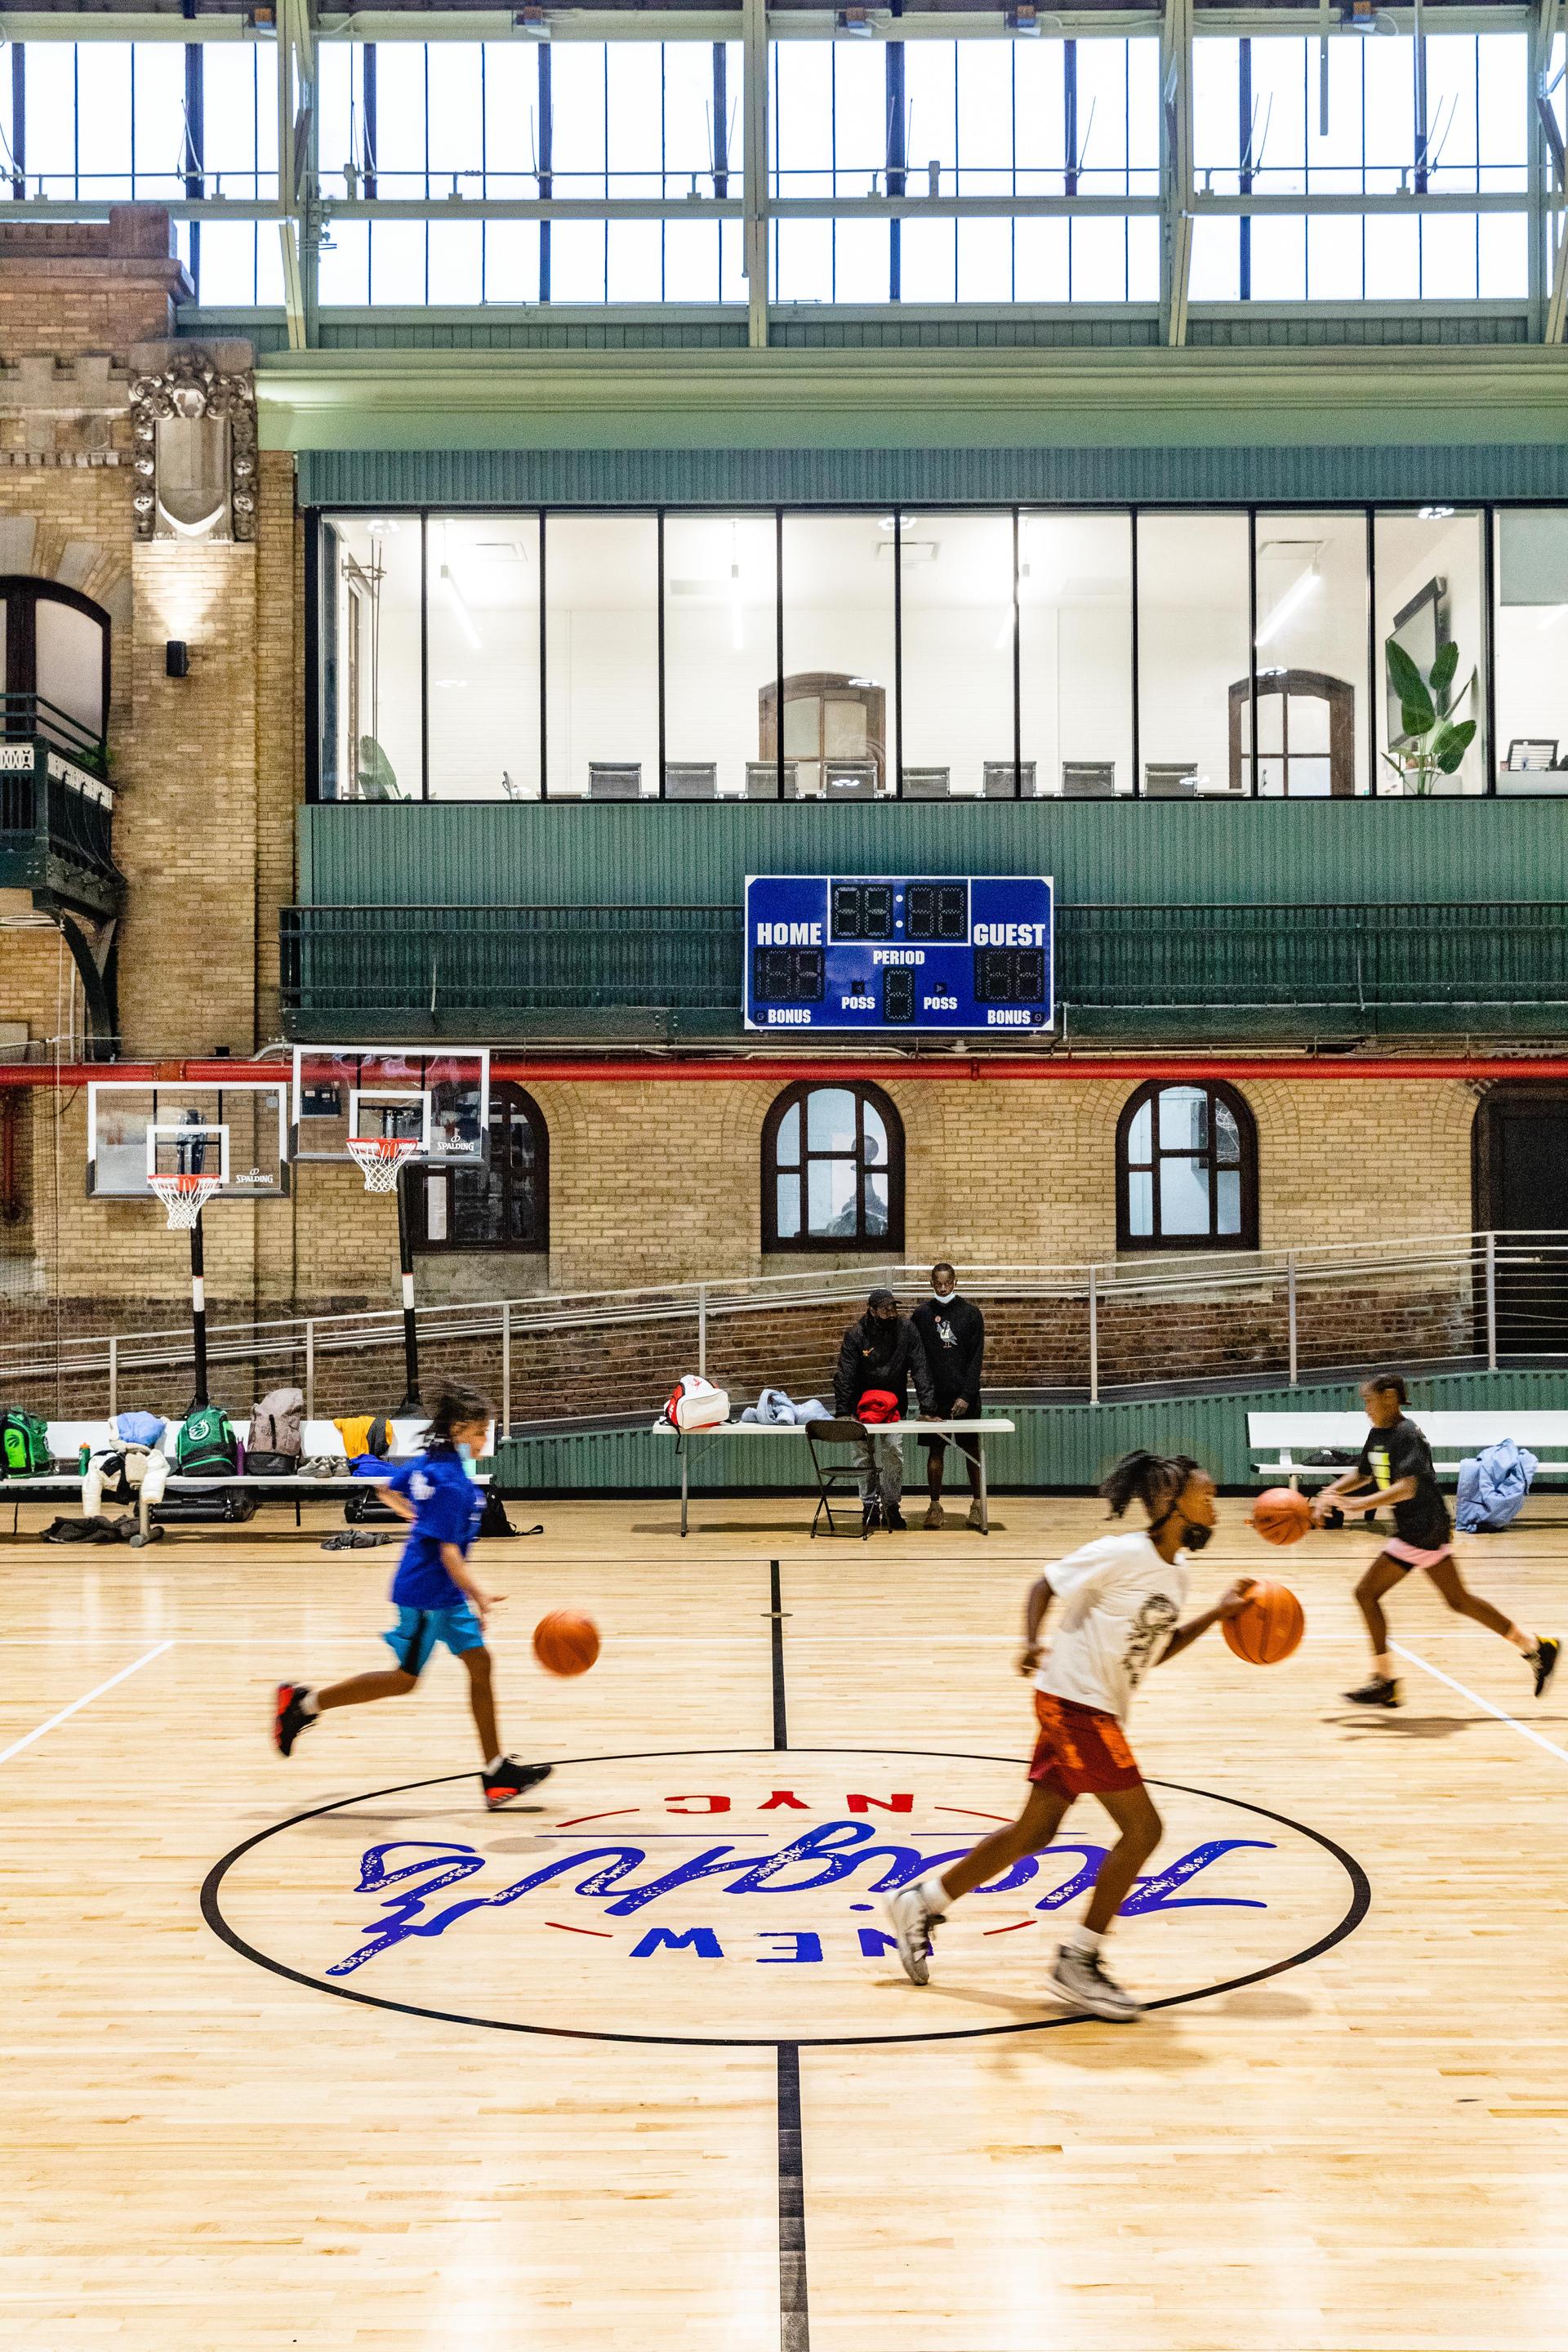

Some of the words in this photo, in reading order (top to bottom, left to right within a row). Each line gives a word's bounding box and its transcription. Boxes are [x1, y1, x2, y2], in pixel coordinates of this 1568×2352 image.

[758, 923, 822, 945] HOME
[973, 924, 1045, 946] GUEST
[873, 951, 925, 965] PERIOD
[841, 997, 875, 1009] POSS
[924, 997, 957, 1010] POSS
[768, 1009, 811, 1024] BONUS
[987, 1010, 1031, 1025] BONUS
[437, 1142, 474, 1152] SPALDING
[236, 1174, 274, 1183] SPALDING
[663, 1790, 914, 1815] NYC
